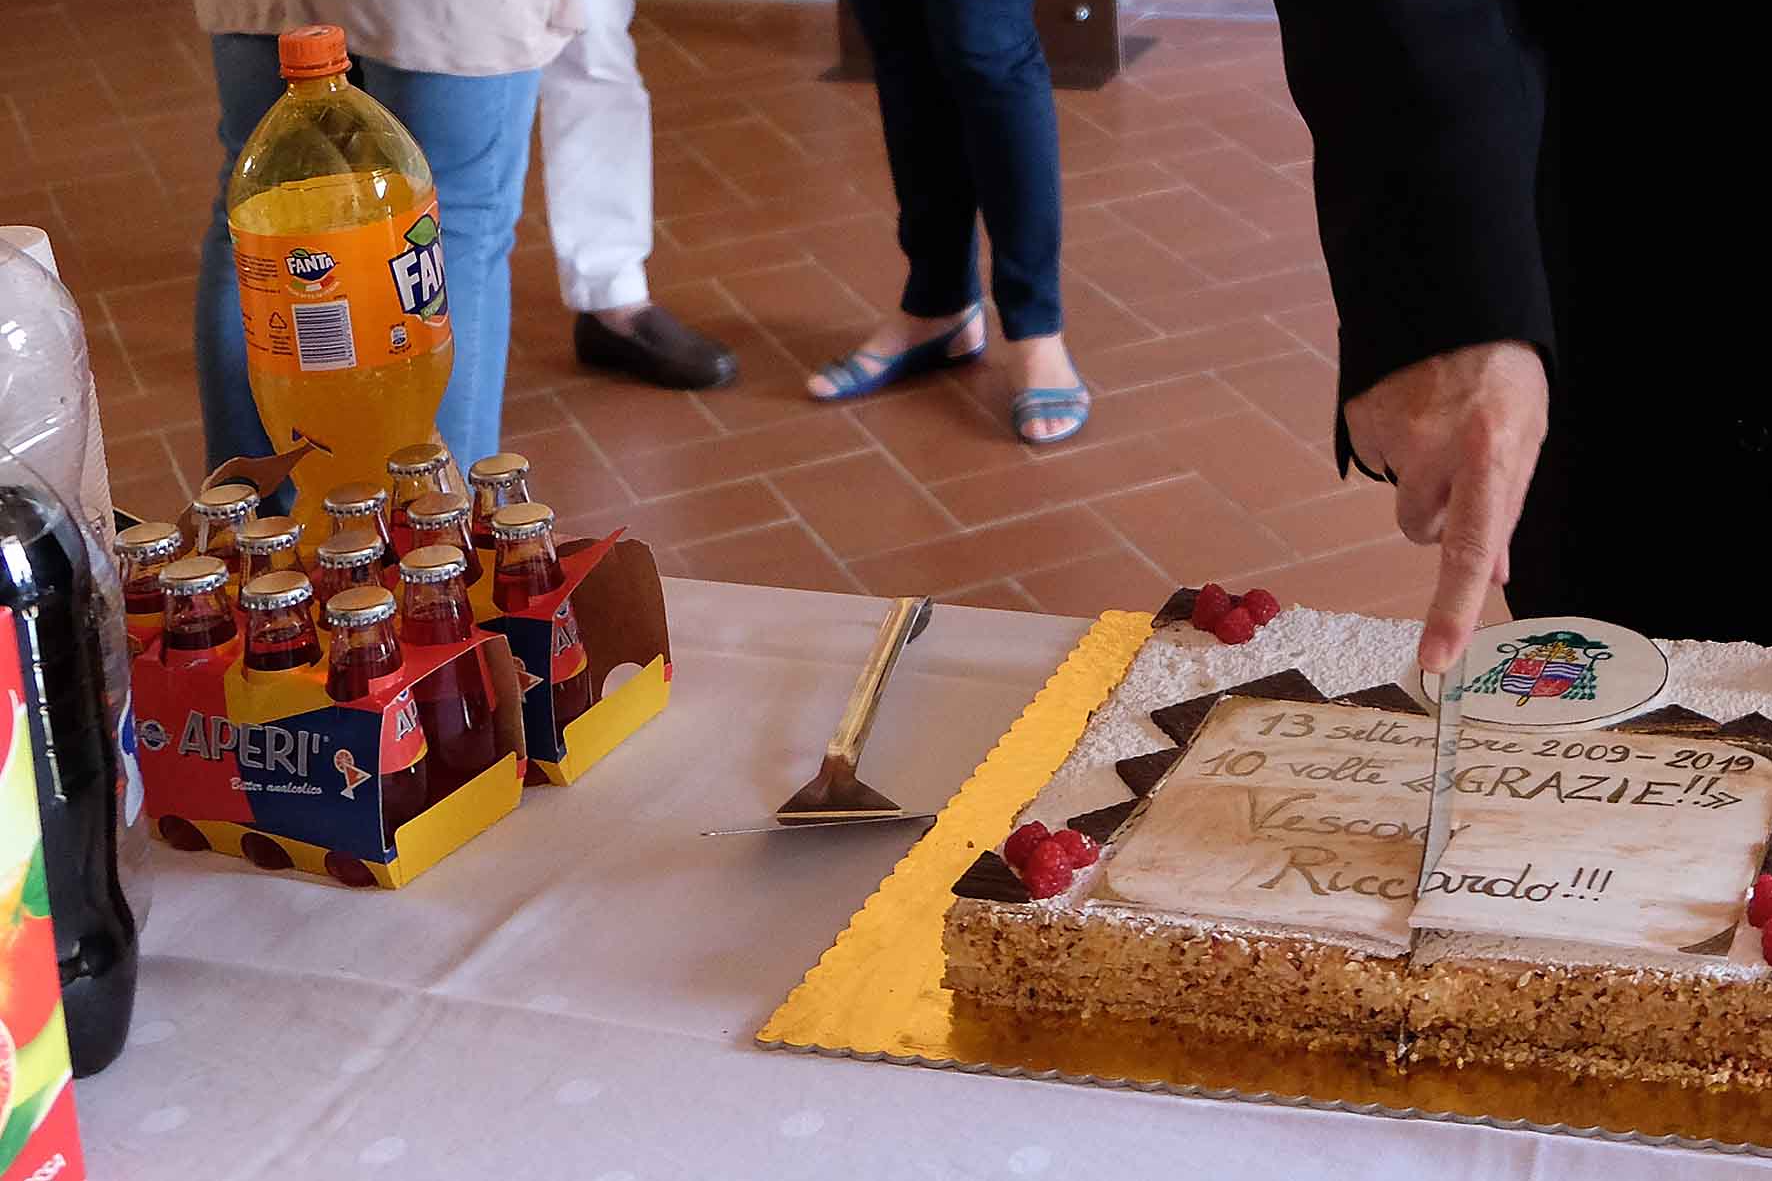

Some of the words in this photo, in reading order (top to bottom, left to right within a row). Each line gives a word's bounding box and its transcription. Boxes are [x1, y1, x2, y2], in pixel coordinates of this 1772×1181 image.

[286, 253, 334, 275] FANTA
[1257, 712, 1316, 738] 13
[1200, 748, 1267, 777] 10
[1288, 756, 1402, 786] volte
